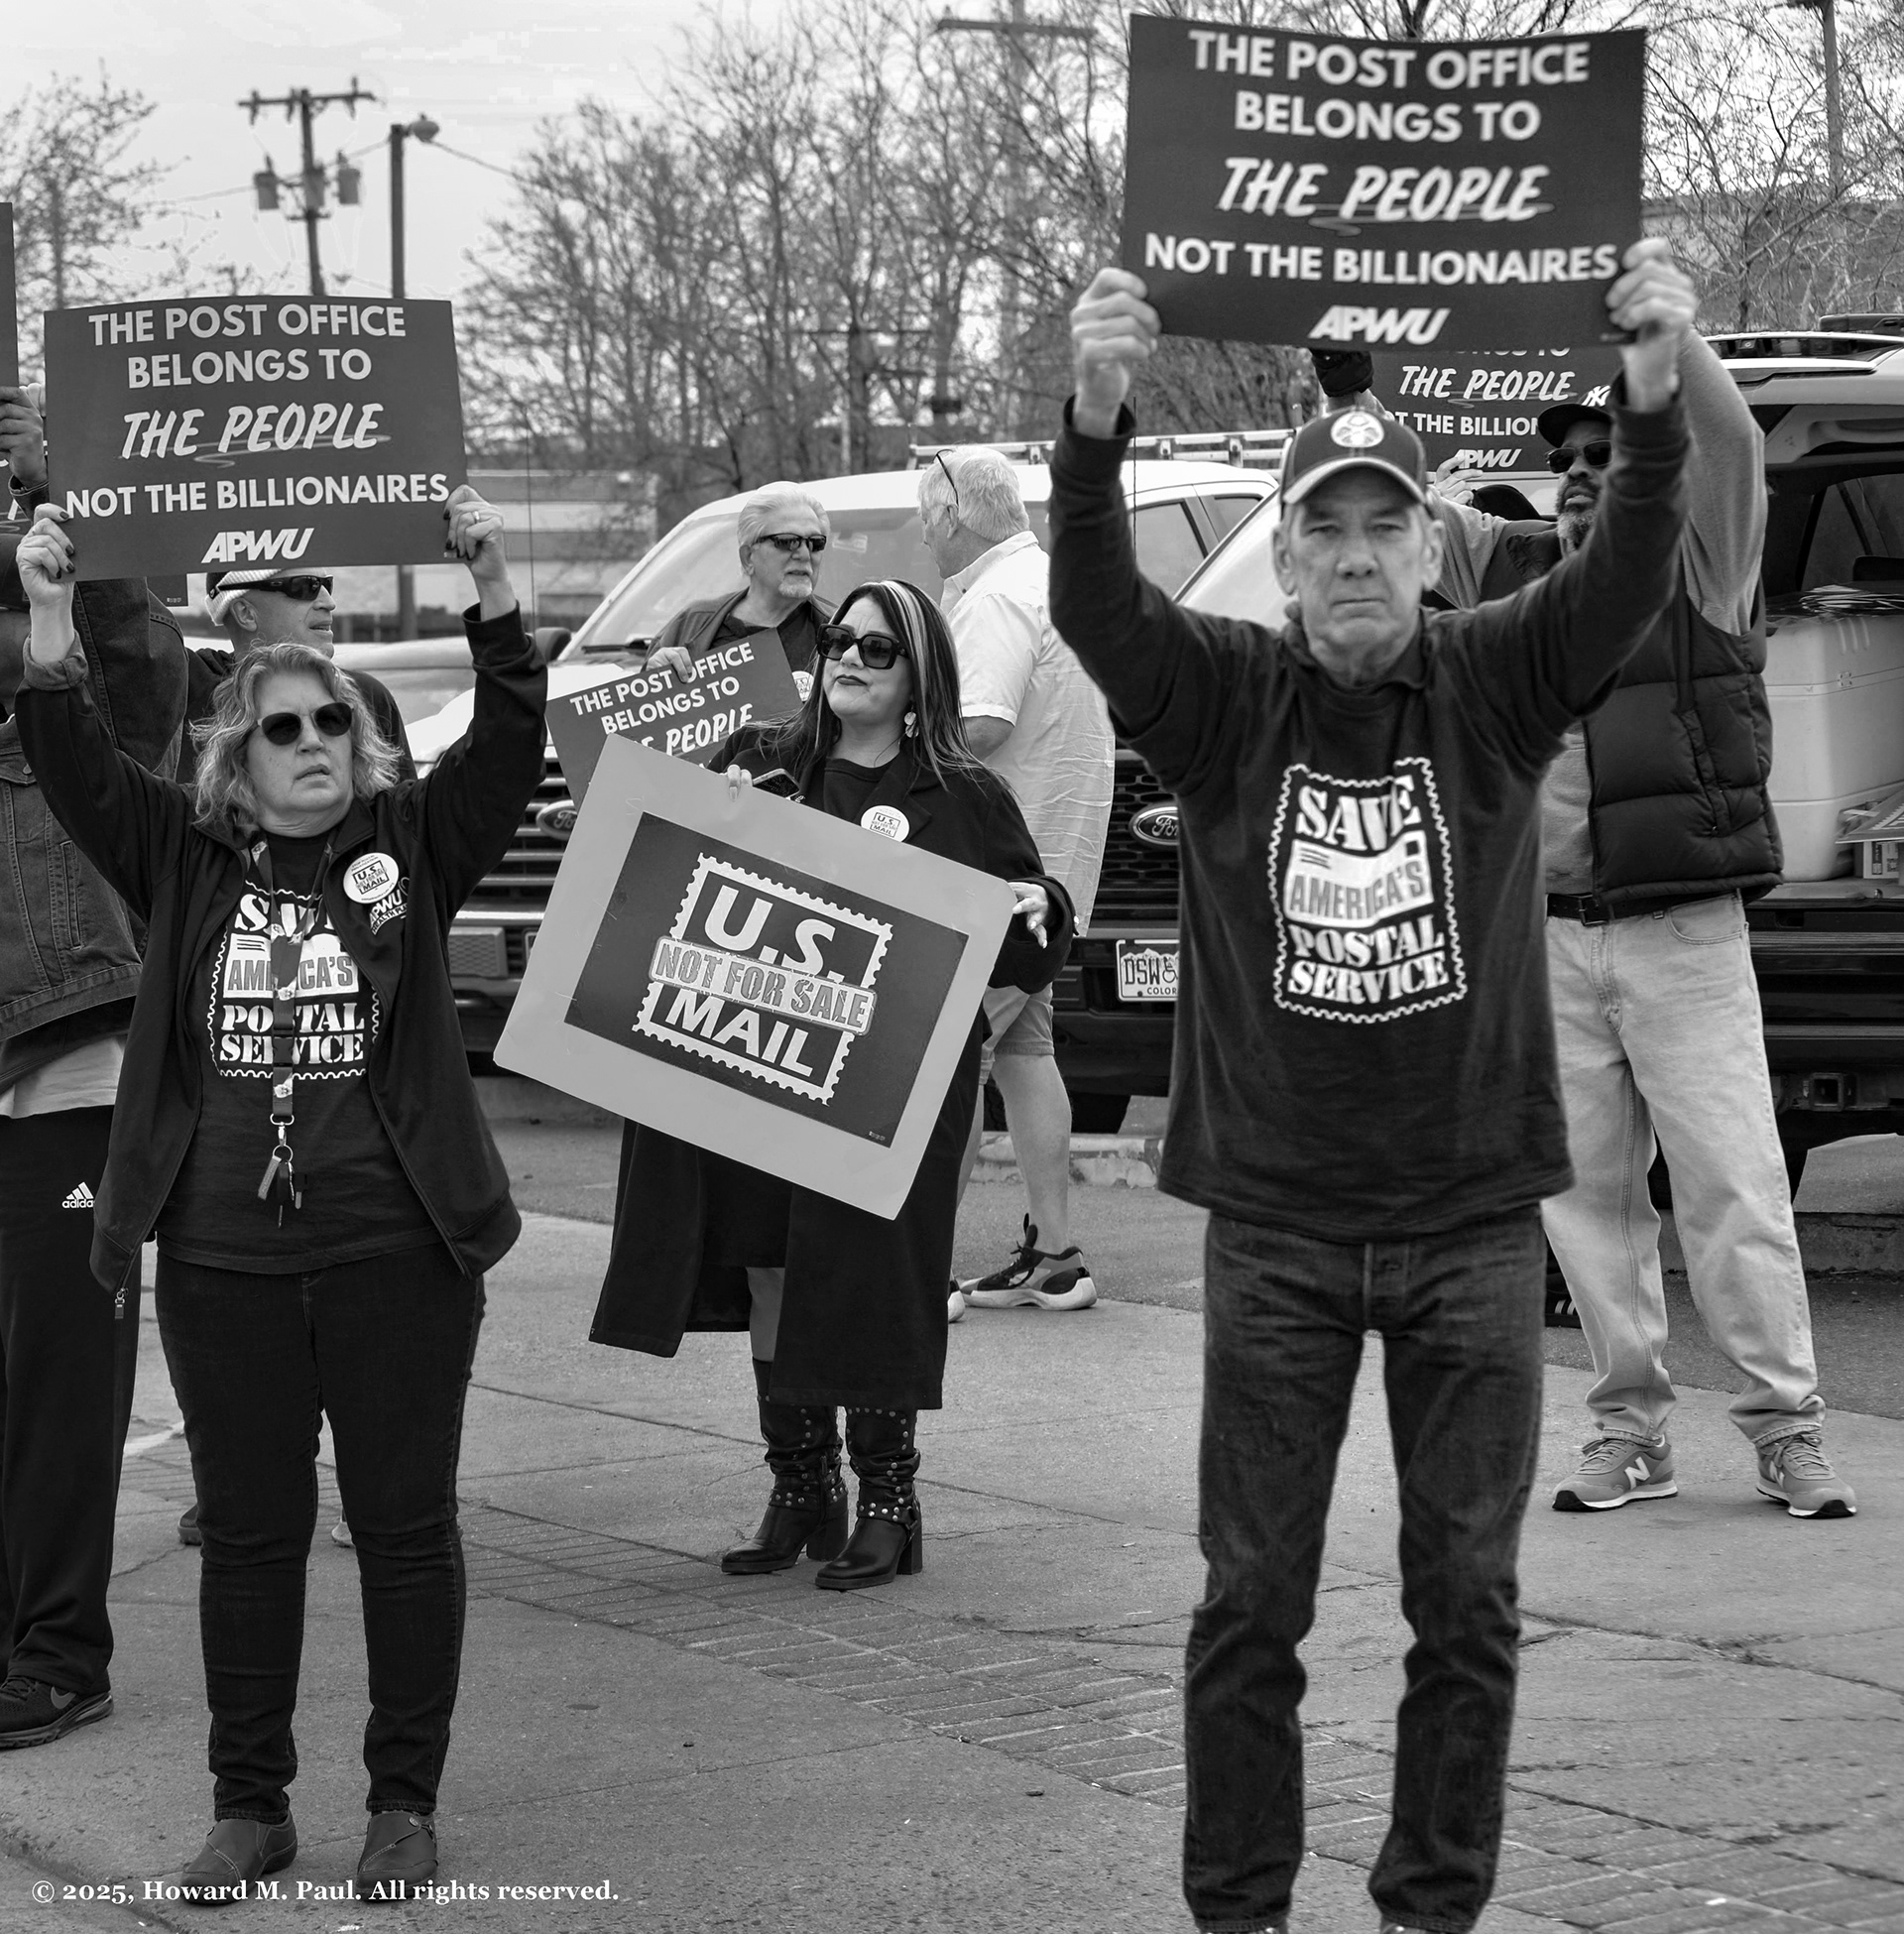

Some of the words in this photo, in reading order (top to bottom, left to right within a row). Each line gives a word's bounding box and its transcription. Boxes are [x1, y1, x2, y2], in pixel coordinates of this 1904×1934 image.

[1189, 31, 1275, 78] THE
[1289, 41, 1417, 89] POST
[1425, 43, 1591, 90] OFFICE
[1235, 90, 1463, 143] BELONGS
[1474, 101, 1541, 141] TO
[1218, 157, 1328, 218] THE
[1339, 164, 1550, 222] PEOPLE
[1145, 232, 1236, 275] NOT
[1245, 243, 1322, 281] THE
[1334, 244, 1618, 286] BILLIONAIRES
[88, 309, 155, 346] THE
[166, 304, 268, 340] POST
[278, 304, 407, 338] OFFICE
[1309, 303, 1451, 346] APWU
[127, 348, 309, 389] BELONGS
[319, 348, 372, 381] TO
[1399, 365, 1457, 399] THE
[1463, 369, 1576, 402] PEOPLE
[122, 409, 204, 460] THE
[218, 402, 385, 454] PEOPLE
[1413, 413, 1455, 434] THE
[66, 486, 137, 519] NOT
[145, 481, 207, 513] THE
[217, 473, 451, 510] BILLIONAIRES
[201, 528, 315, 564] APWU
[569, 691, 614, 716] THE
[615, 669, 675, 704] POST
[601, 687, 705, 735] BELONGS
[707, 676, 740, 701] TO
[1295, 775, 1422, 851] SAVE
[363, 877, 386, 892] MAIL
[1290, 861, 1425, 920] AMERICA'S
[370, 889, 403, 927] APWU
[372, 909, 395, 931] HEALTH
[704, 885, 845, 984] U.S.
[1288, 914, 1445, 968] POSTAL
[228, 955, 353, 991] AMCA'S
[655, 943, 722, 988] NOT
[724, 961, 786, 1007] FOR
[791, 979, 869, 1028] SALE
[1124, 957, 1160, 985] DSW
[1288, 950, 1450, 1005] SERVICE
[221, 1002, 365, 1032] POTAL
[665, 988, 813, 1078] MAIL
[61, 1199, 94, 1208] adida
